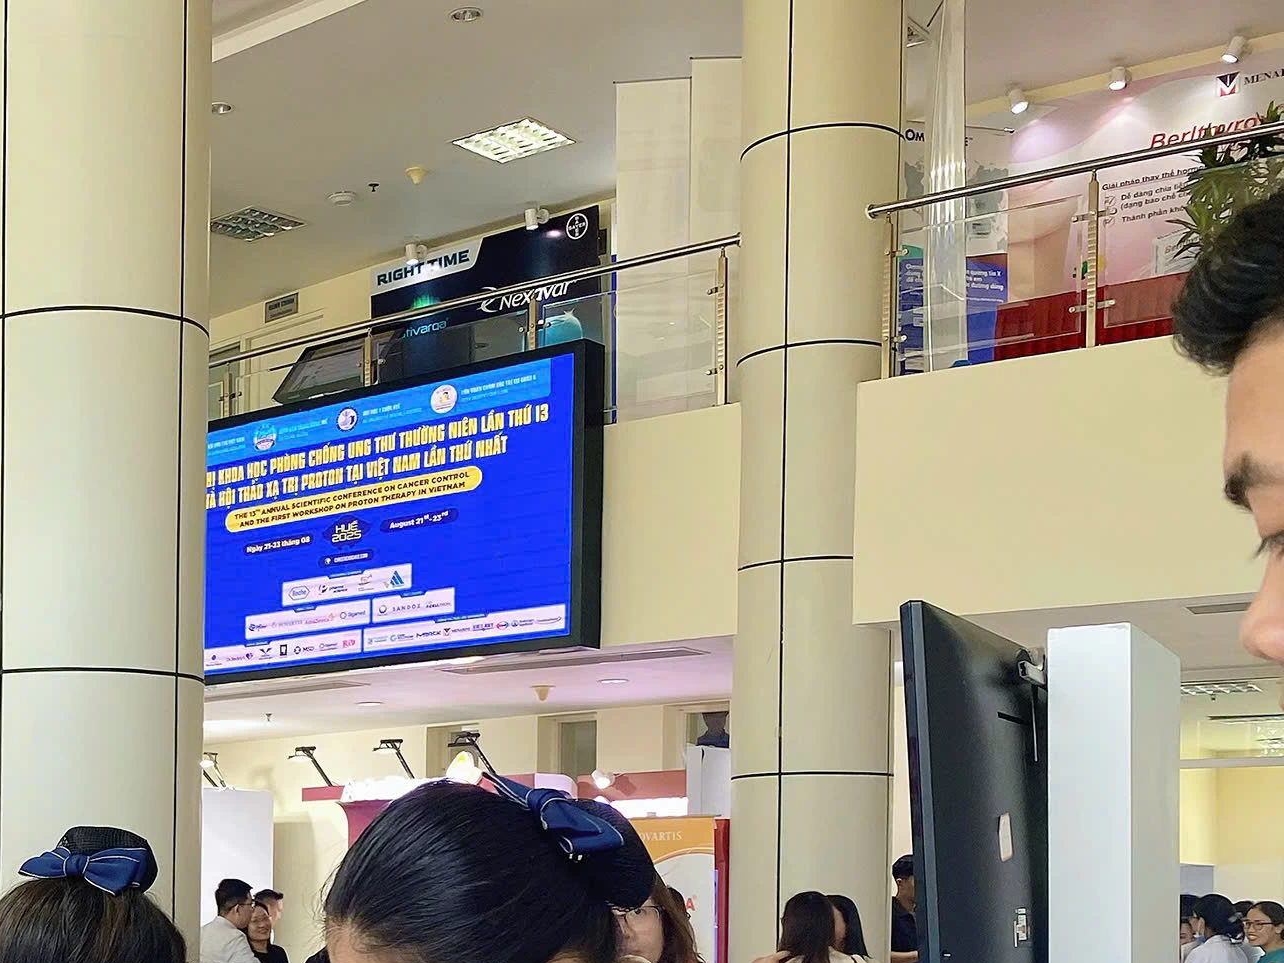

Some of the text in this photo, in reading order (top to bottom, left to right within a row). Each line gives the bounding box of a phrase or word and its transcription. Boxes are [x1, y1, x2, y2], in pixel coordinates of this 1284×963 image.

[377, 261, 425, 286] RIGHT
[218, 465, 244, 485] KHOA
[246, 460, 267, 483] HỌC
[270, 452, 306, 474] PHÒNG
[308, 442, 345, 467] CHỐNG
[448, 416, 477, 439] NIÊN
[508, 403, 533, 428] THỨ
[535, 403, 549, 423] 13
[218, 487, 235, 509] HỘI
[282, 476, 298, 496] TRỊ
[301, 468, 343, 491] PROTON
[346, 463, 363, 485] TẠI
[366, 457, 390, 481] VIỆT
[393, 452, 420, 474] NAM
[450, 439, 472, 463] THỨ
[475, 431, 508, 459] NHẤT
[234, 512, 247, 521] THE
[261, 504, 290, 516] ANNUAL
[291, 496, 331, 510] SCIENTIFIC
[333, 487, 382, 503] CONFERENCE
[384, 484, 395, 493] ON
[397, 478, 429, 491] CANCER
[431, 471, 469, 484] CONTROL
[239, 481, 466, 529] AND THE FIRST WORKSHOP ON PROTON THERAPY IN VIETNAM
[332, 530, 362, 543] 2025
[389, 518, 415, 530] August
[641, 831, 682, 842] OVARTIS
